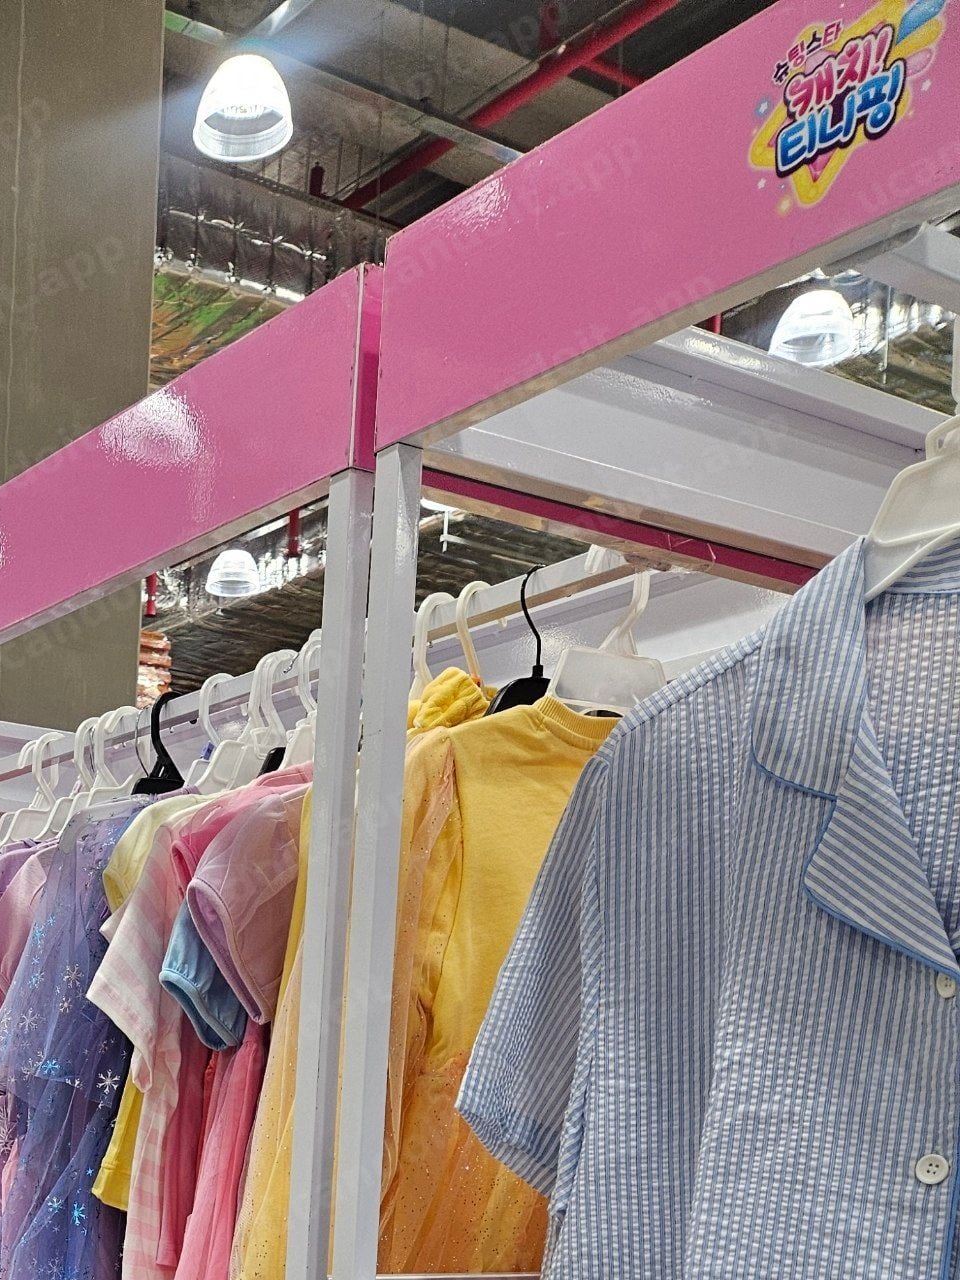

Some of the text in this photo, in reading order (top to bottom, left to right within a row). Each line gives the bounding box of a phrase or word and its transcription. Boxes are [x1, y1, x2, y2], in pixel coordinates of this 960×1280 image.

[773, 20, 842, 85] 슈팅스타
[787, 27, 893, 118] 캐치!
[776, 60, 905, 172] 티니핑
